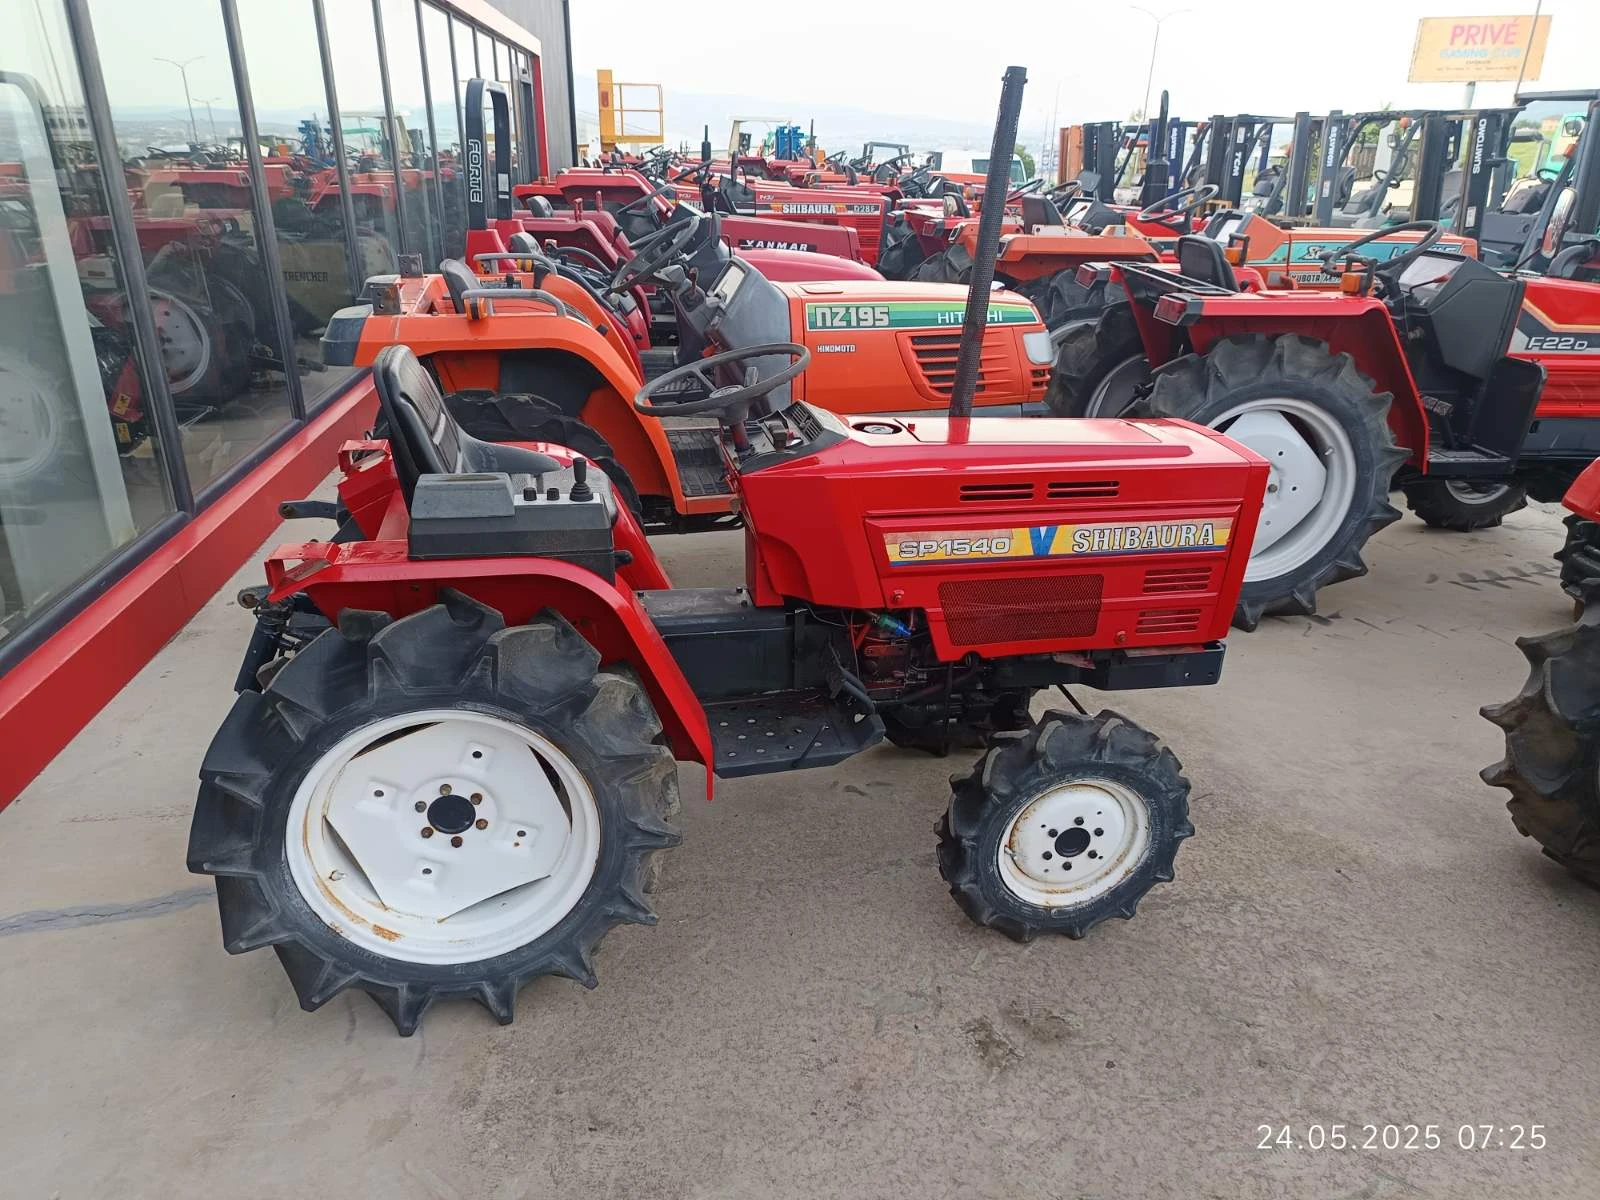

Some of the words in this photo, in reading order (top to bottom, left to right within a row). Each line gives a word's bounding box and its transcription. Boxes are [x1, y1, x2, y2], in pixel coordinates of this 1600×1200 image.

[1449, 17, 1520, 46] PRIVÉ
[1326, 126, 1338, 168] KOMATSU
[1473, 118, 1487, 174] SUMITOMO
[468, 138, 483, 203] FORTE
[782, 203, 837, 215] SHIBAURA
[741, 239, 808, 251] YANMAR
[283, 271, 329, 282] TRENCHER
[815, 305, 889, 328] NZ195
[937, 309, 1003, 324] HITHI
[817, 344, 856, 353] HINOMOTO
[899, 537, 1011, 558] SP1540
[1072, 523, 1215, 552] SHIBAURA
